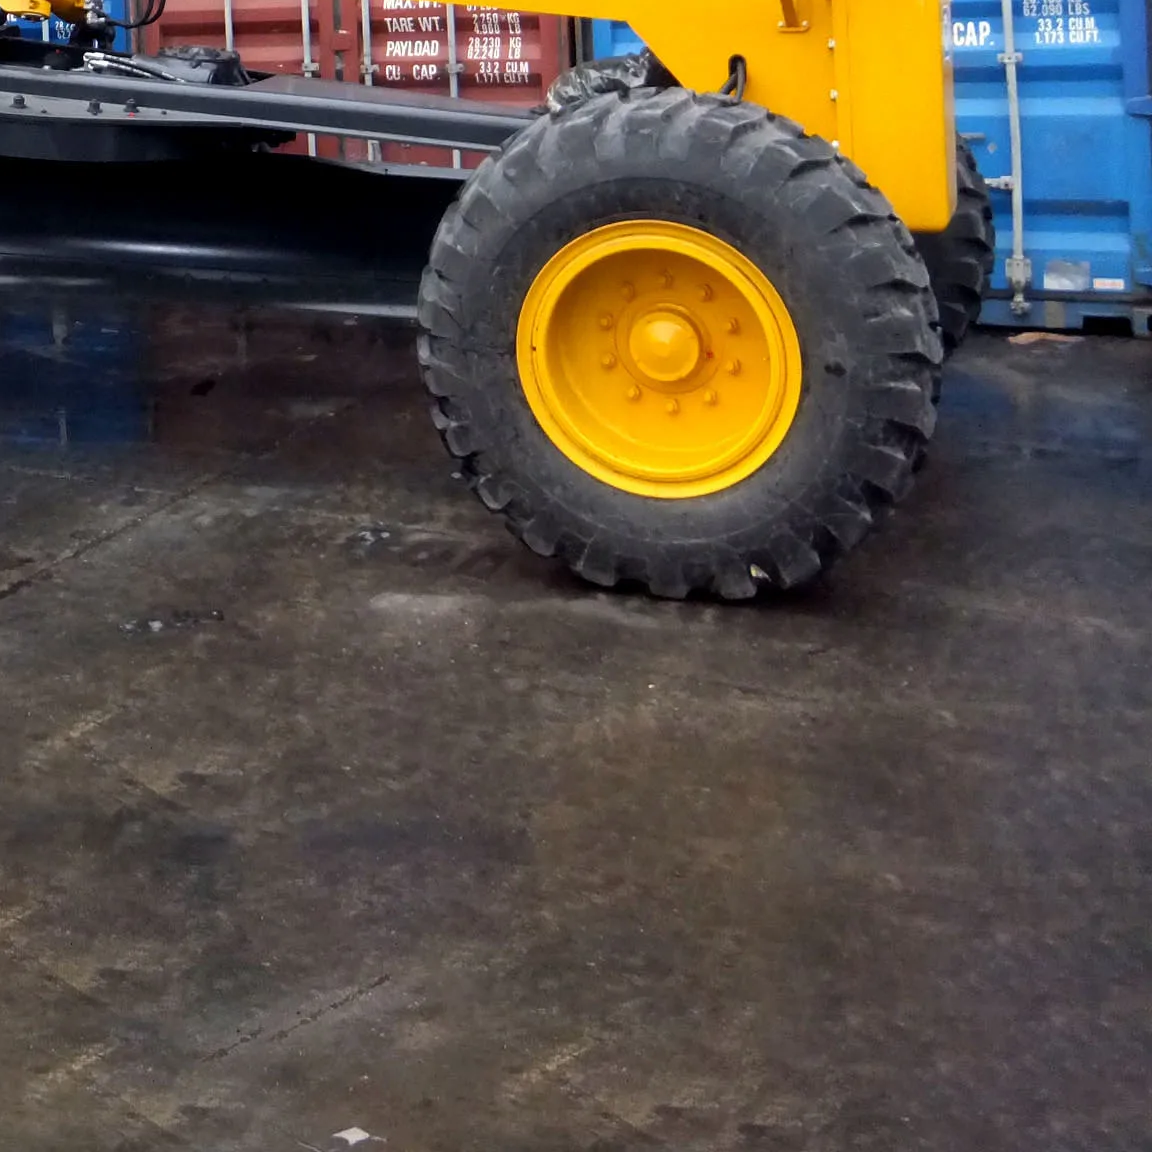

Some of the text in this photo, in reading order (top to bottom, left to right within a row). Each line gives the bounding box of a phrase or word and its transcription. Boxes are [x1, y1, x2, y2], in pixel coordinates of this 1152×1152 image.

[1068, 3, 1090, 15] LBS
[384, 16, 444, 33] TARE WT.
[507, 12, 520, 24] KG
[953, 21, 994, 46] CAP.
[386, 40, 439, 57] PAYLOAD
[509, 36, 522, 48] KG
[508, 48, 521, 59] LB
[412, 64, 441, 80] CAP.
